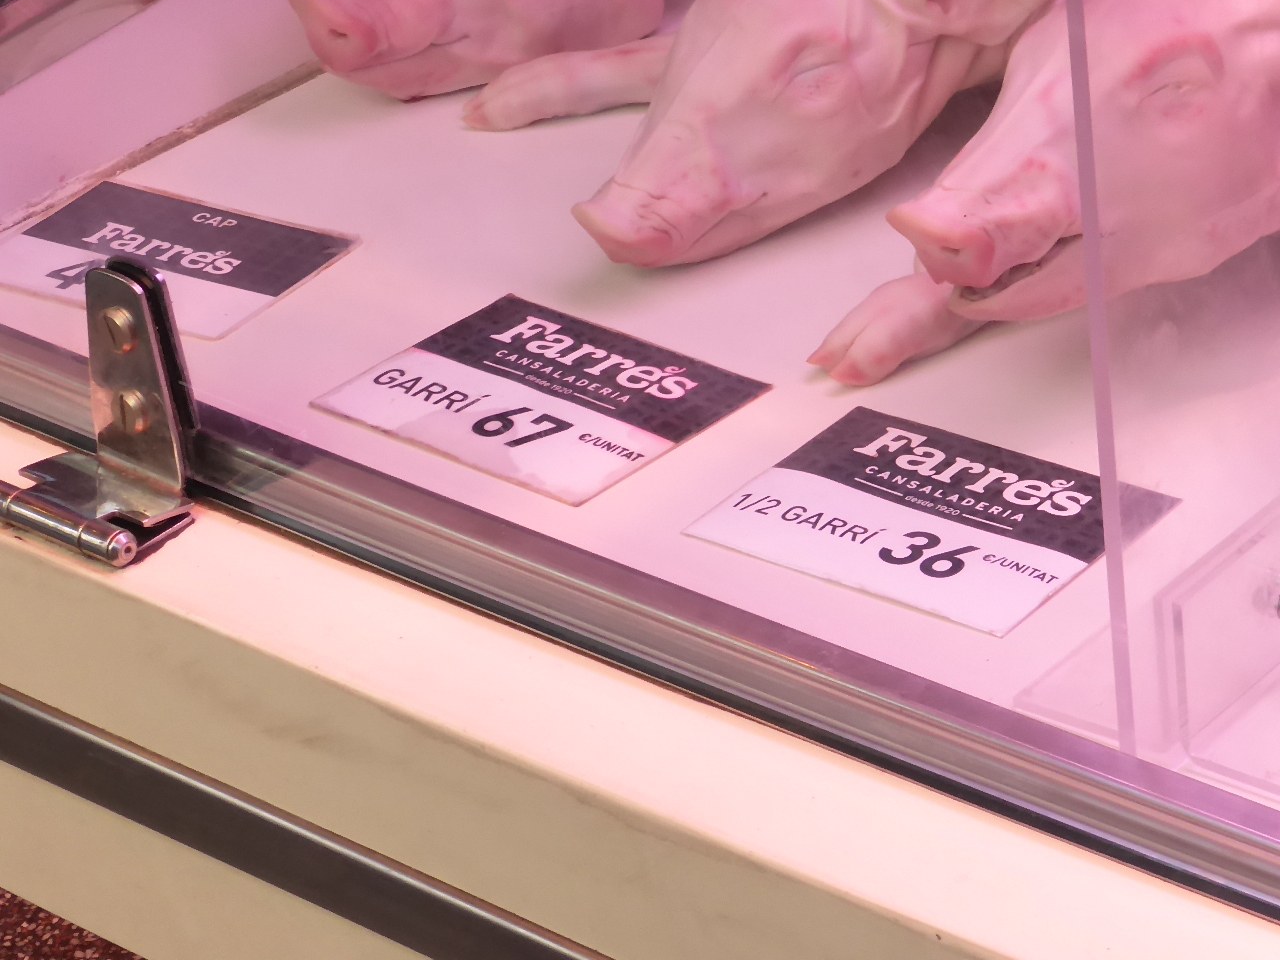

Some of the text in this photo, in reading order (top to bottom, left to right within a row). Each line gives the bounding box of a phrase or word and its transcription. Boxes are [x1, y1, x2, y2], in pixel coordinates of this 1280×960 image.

[192, 212, 238, 229] CAP
[495, 350, 632, 404] CANSALADERIA
[373, 368, 645, 463] GARRÍ 67 €/UNITAT
[865, 464, 1026, 523] CANSALADERIA
[904, 493, 961, 516] desde 1920
[732, 492, 1059, 585] 1/2 GARRÍ 36 €/UNITAT
